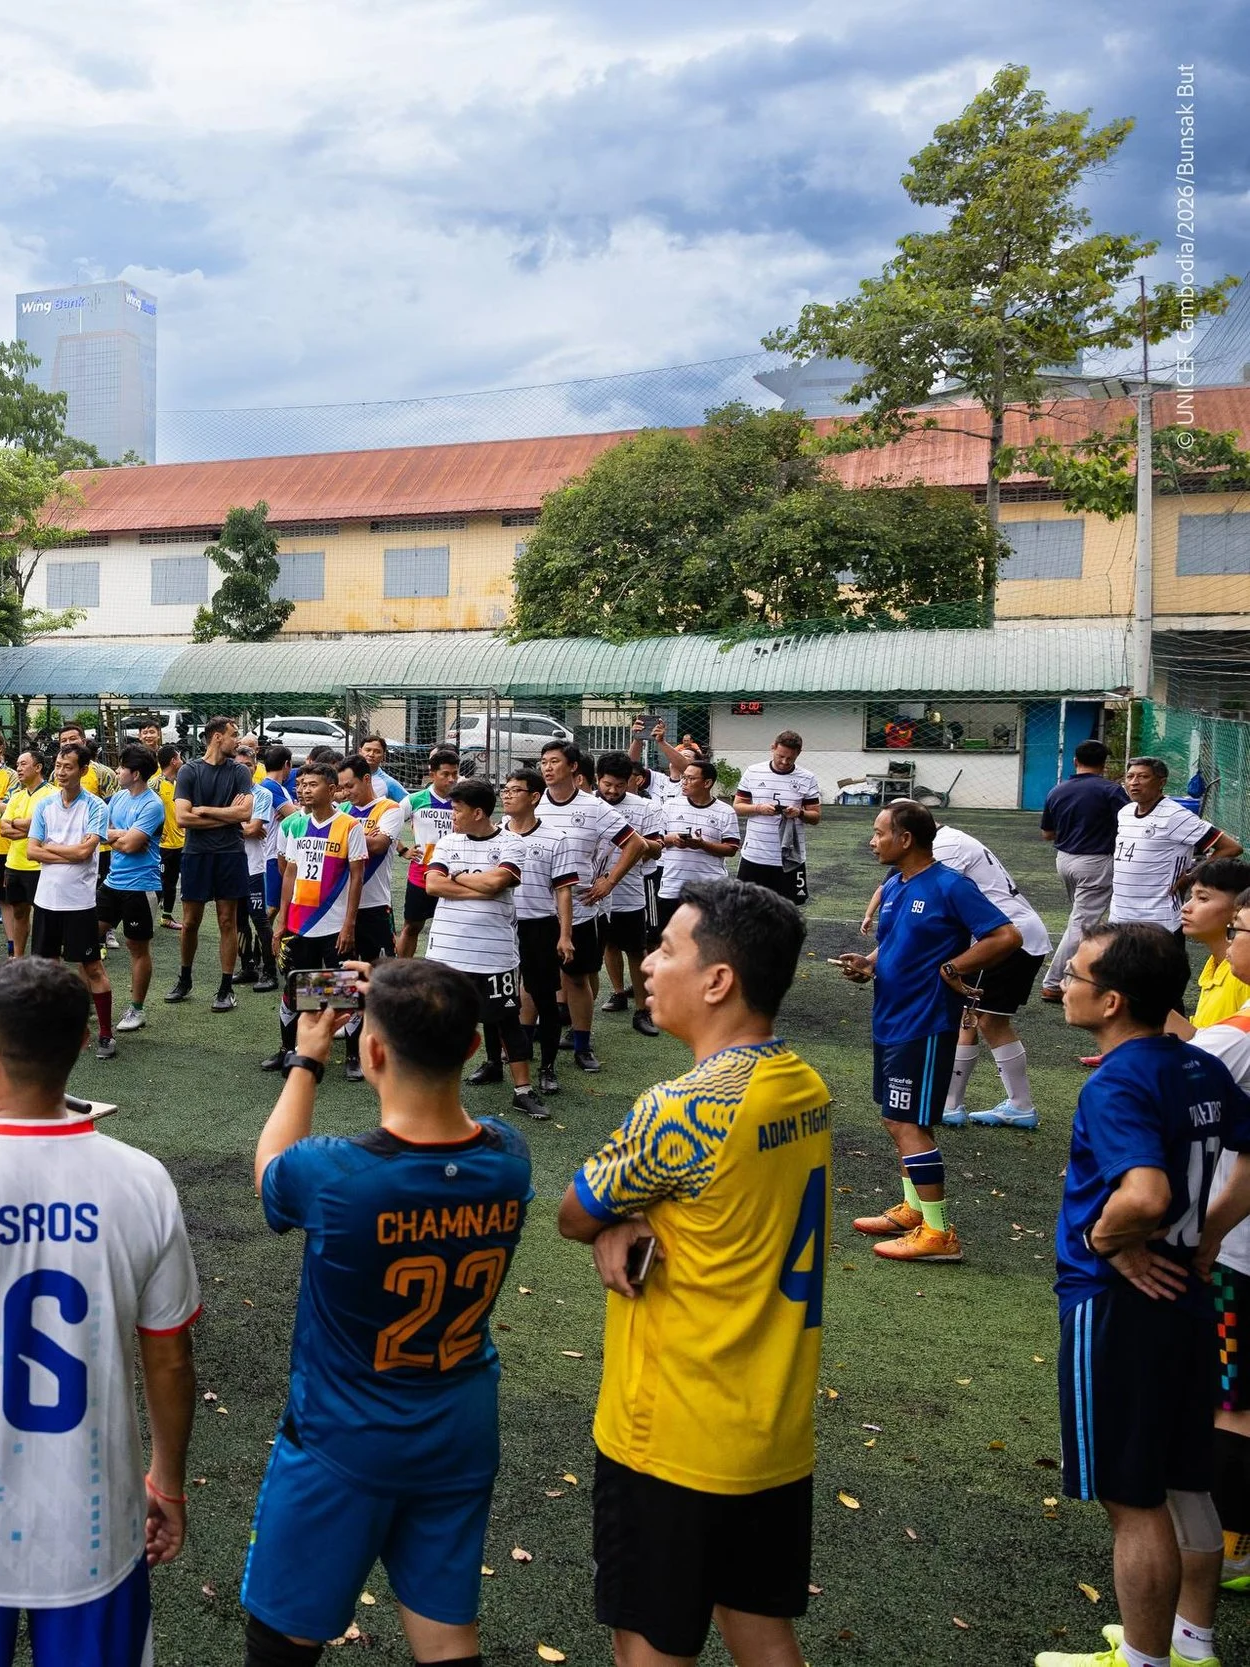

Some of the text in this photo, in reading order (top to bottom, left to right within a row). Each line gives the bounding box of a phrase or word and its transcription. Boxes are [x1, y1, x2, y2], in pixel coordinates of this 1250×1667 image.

[21, 297, 85, 315] Wing Bank
[772, 793, 781, 806] 5
[420, 810, 452, 820] INGO UN
[434, 819, 452, 829] TEAM
[313, 840, 341, 853] UNITED
[1115, 841, 1135, 862] 14
[305, 851, 323, 863] TEAM
[305, 864, 318, 880] 32
[796, 872, 805, 888] 5
[251, 900, 263, 910] 72
[911, 900, 925, 914] 99
[487, 972, 515, 999] 18
[889, 1090, 911, 1110] 99
[758, 1115, 799, 1152] ADAM
[376, 1199, 520, 1245] CHAMNAB
[778, 1164, 827, 1330] 4
[373, 1246, 507, 1372] 22
[2, 1268, 88, 1434] 6
